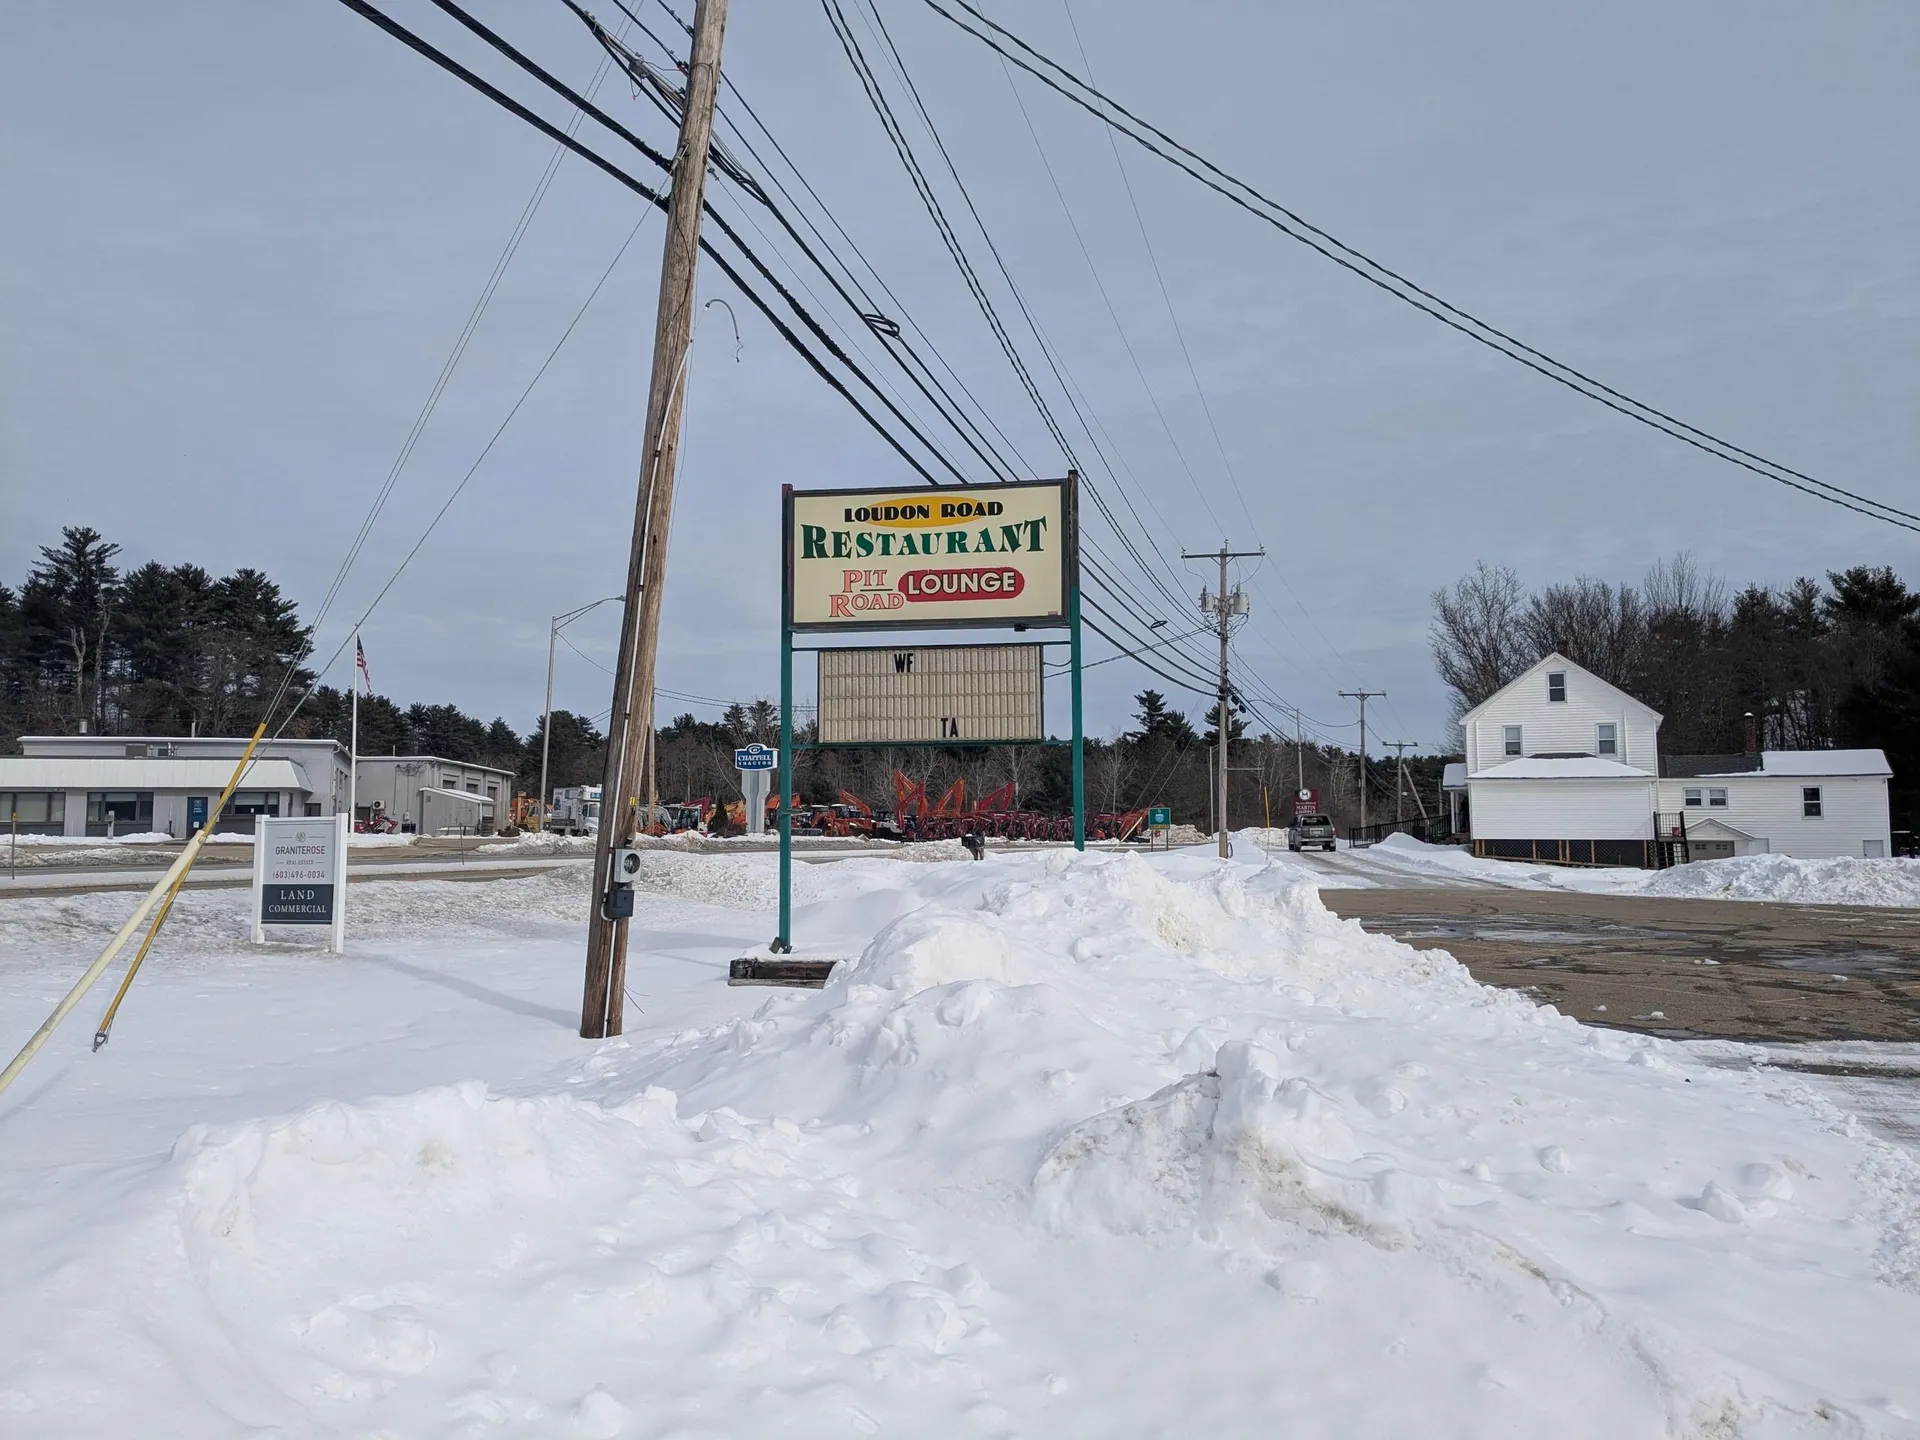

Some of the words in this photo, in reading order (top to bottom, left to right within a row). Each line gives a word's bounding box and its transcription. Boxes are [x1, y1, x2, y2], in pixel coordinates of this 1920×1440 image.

[844, 504, 930, 523] LOUDON
[941, 501, 1004, 518] ROAD
[800, 515, 1047, 560] RESTAURANT
[841, 569, 888, 593] PIT
[907, 570, 1016, 596] LOUNGE
[828, 592, 905, 618] ROAD
[894, 652, 914, 673] WF
[275, 846, 326, 855] GRANITEROSE
[272, 870, 325, 879] (603)496-0034
[280, 889, 315, 900] LAND
[268, 905, 327, 913] COMMERCIAL
